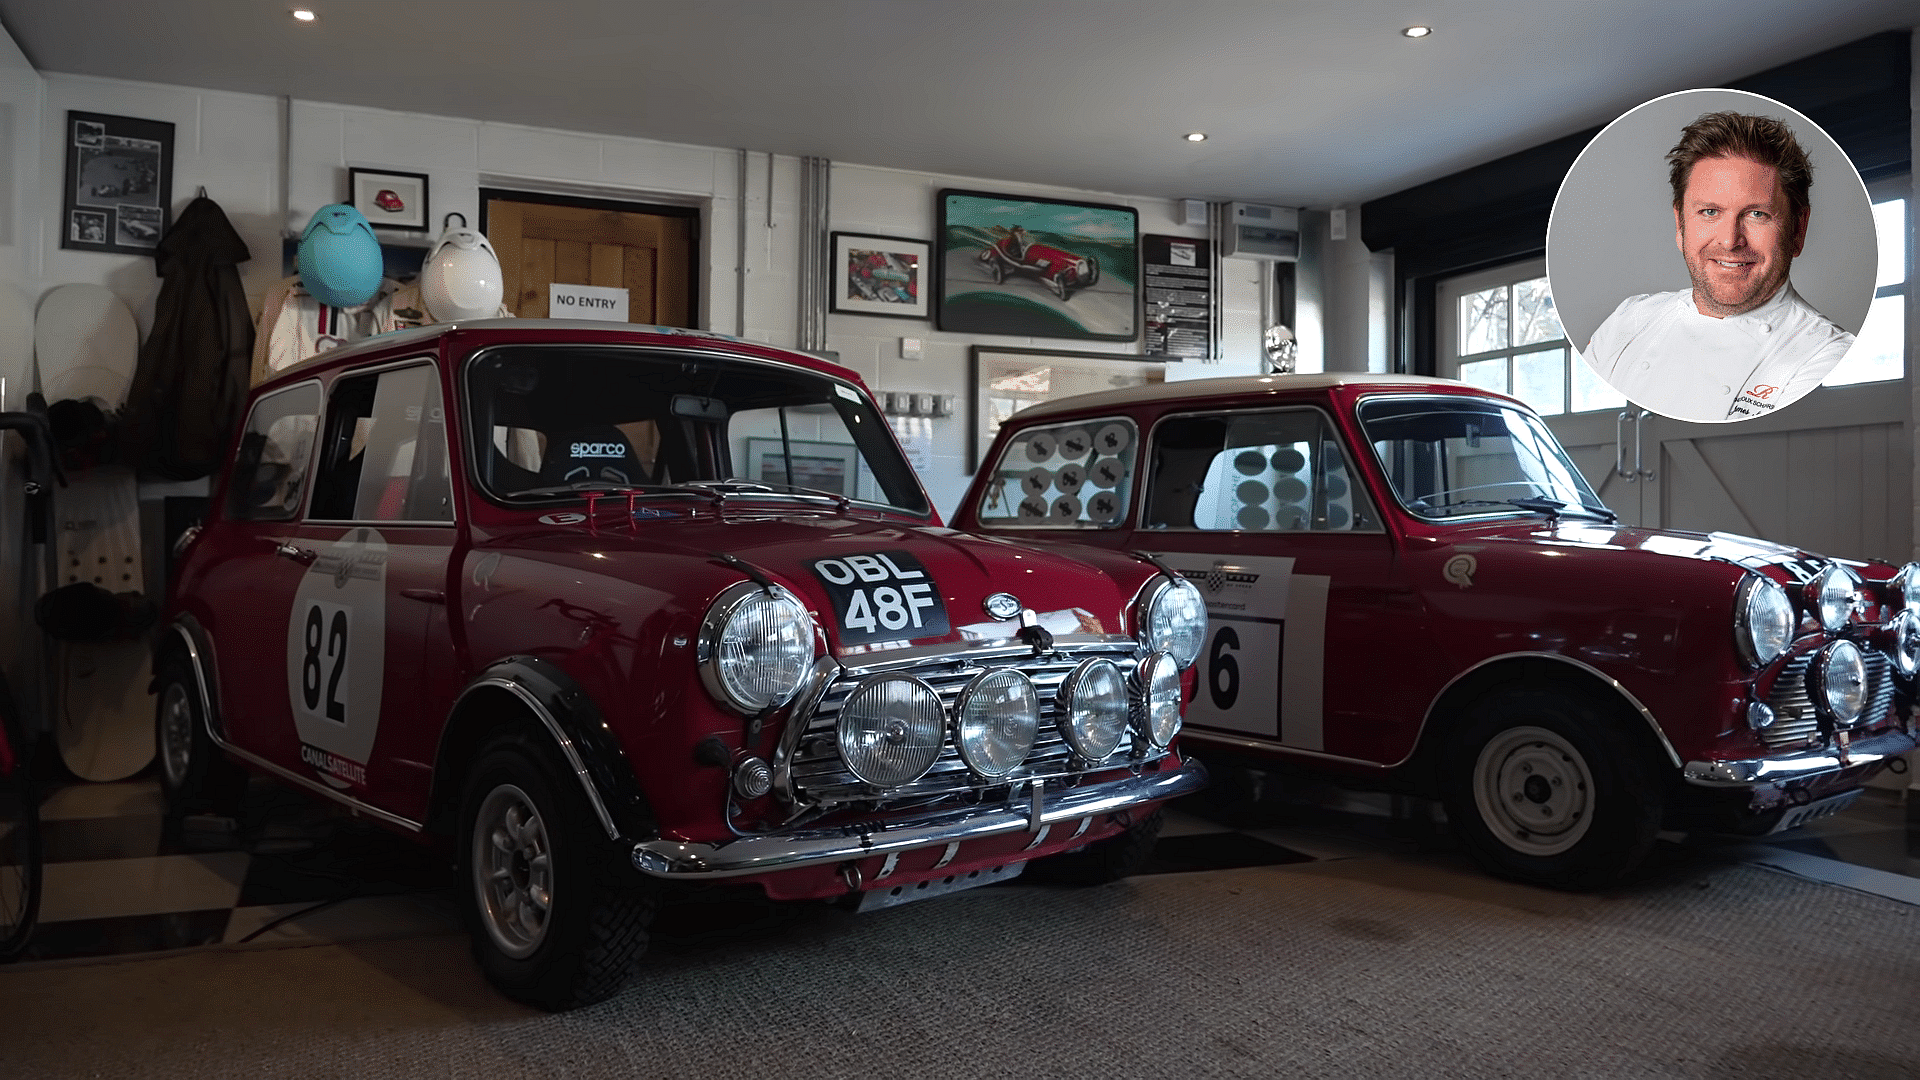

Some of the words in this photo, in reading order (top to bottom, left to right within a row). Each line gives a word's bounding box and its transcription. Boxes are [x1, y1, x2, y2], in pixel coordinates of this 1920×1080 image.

[556, 294, 575, 306] NO
[579, 296, 616, 309] ENTRY
[570, 442, 626, 458] sparco
[814, 553, 925, 585] OBL
[845, 583, 934, 634] 48F
[1205, 601, 1246, 611] astercard
[303, 605, 348, 723] 82
[1189, 626, 1240, 710] 6
[301, 745, 366, 786] CANALSATELLITE
